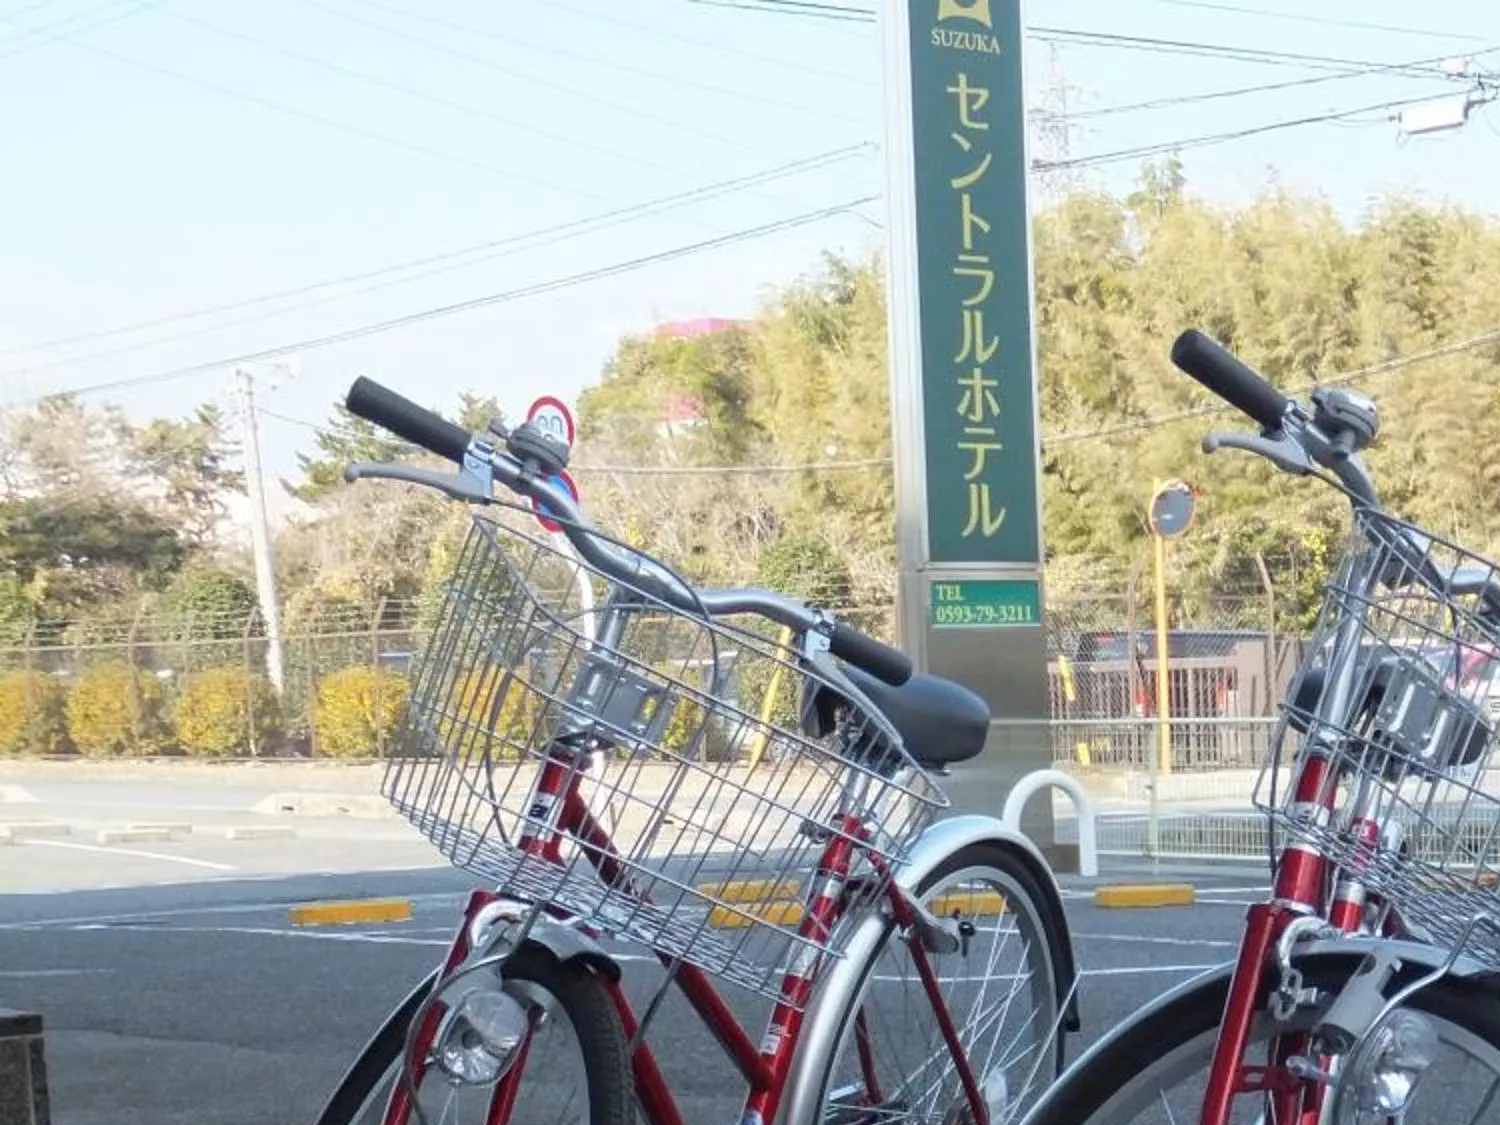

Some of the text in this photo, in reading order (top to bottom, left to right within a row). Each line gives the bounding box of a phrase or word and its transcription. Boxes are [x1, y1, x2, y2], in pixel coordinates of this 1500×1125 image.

[931, 28, 1001, 55] SUZUKA
[946, 72, 1007, 540] セントラルホテル
[935, 584, 964, 601] TEL
[936, 604, 1033, 623] 0593-79-3211
